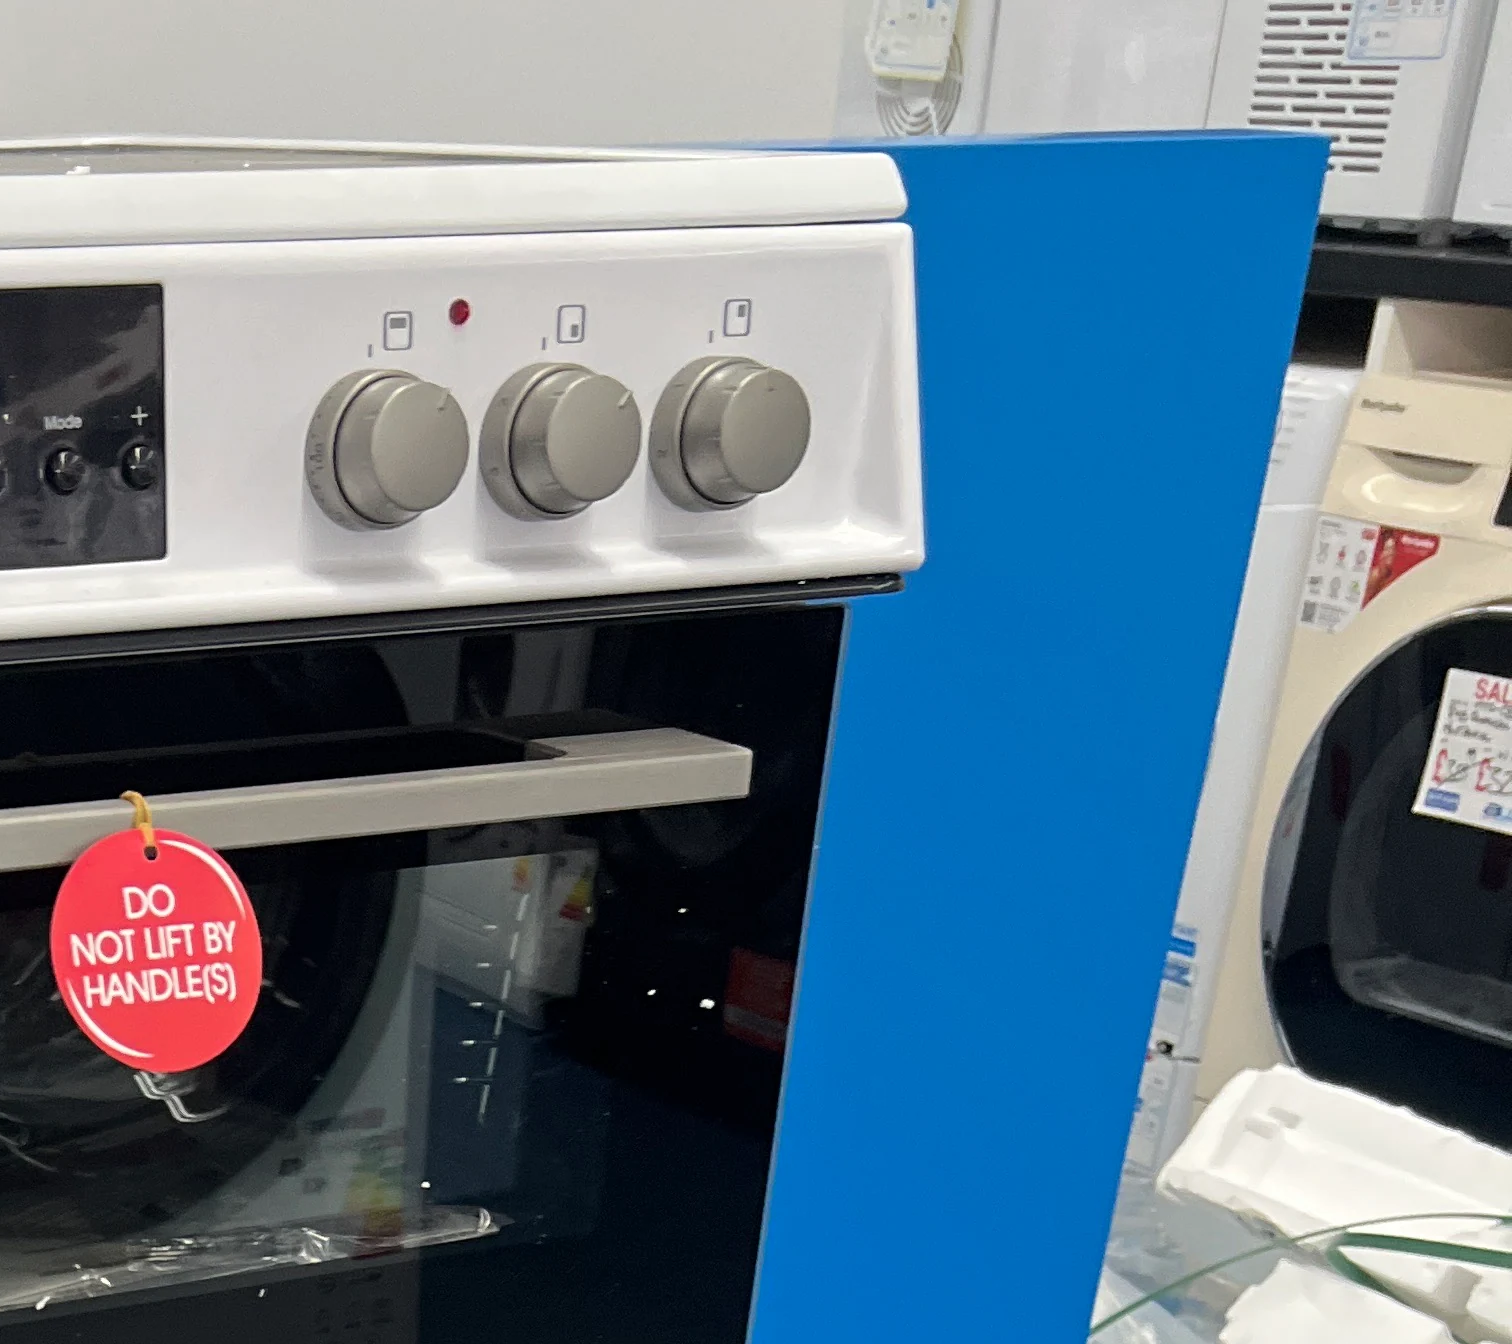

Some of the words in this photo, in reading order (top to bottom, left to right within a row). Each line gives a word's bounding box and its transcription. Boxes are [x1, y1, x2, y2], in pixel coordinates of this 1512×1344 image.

[43, 415, 83, 431] Mode
[122, 883, 176, 920] DO
[70, 928, 136, 968] NOT
[144, 923, 195, 961] LIFT
[202, 920, 236, 955] BY
[83, 962, 237, 1009] HANDLE(S)
